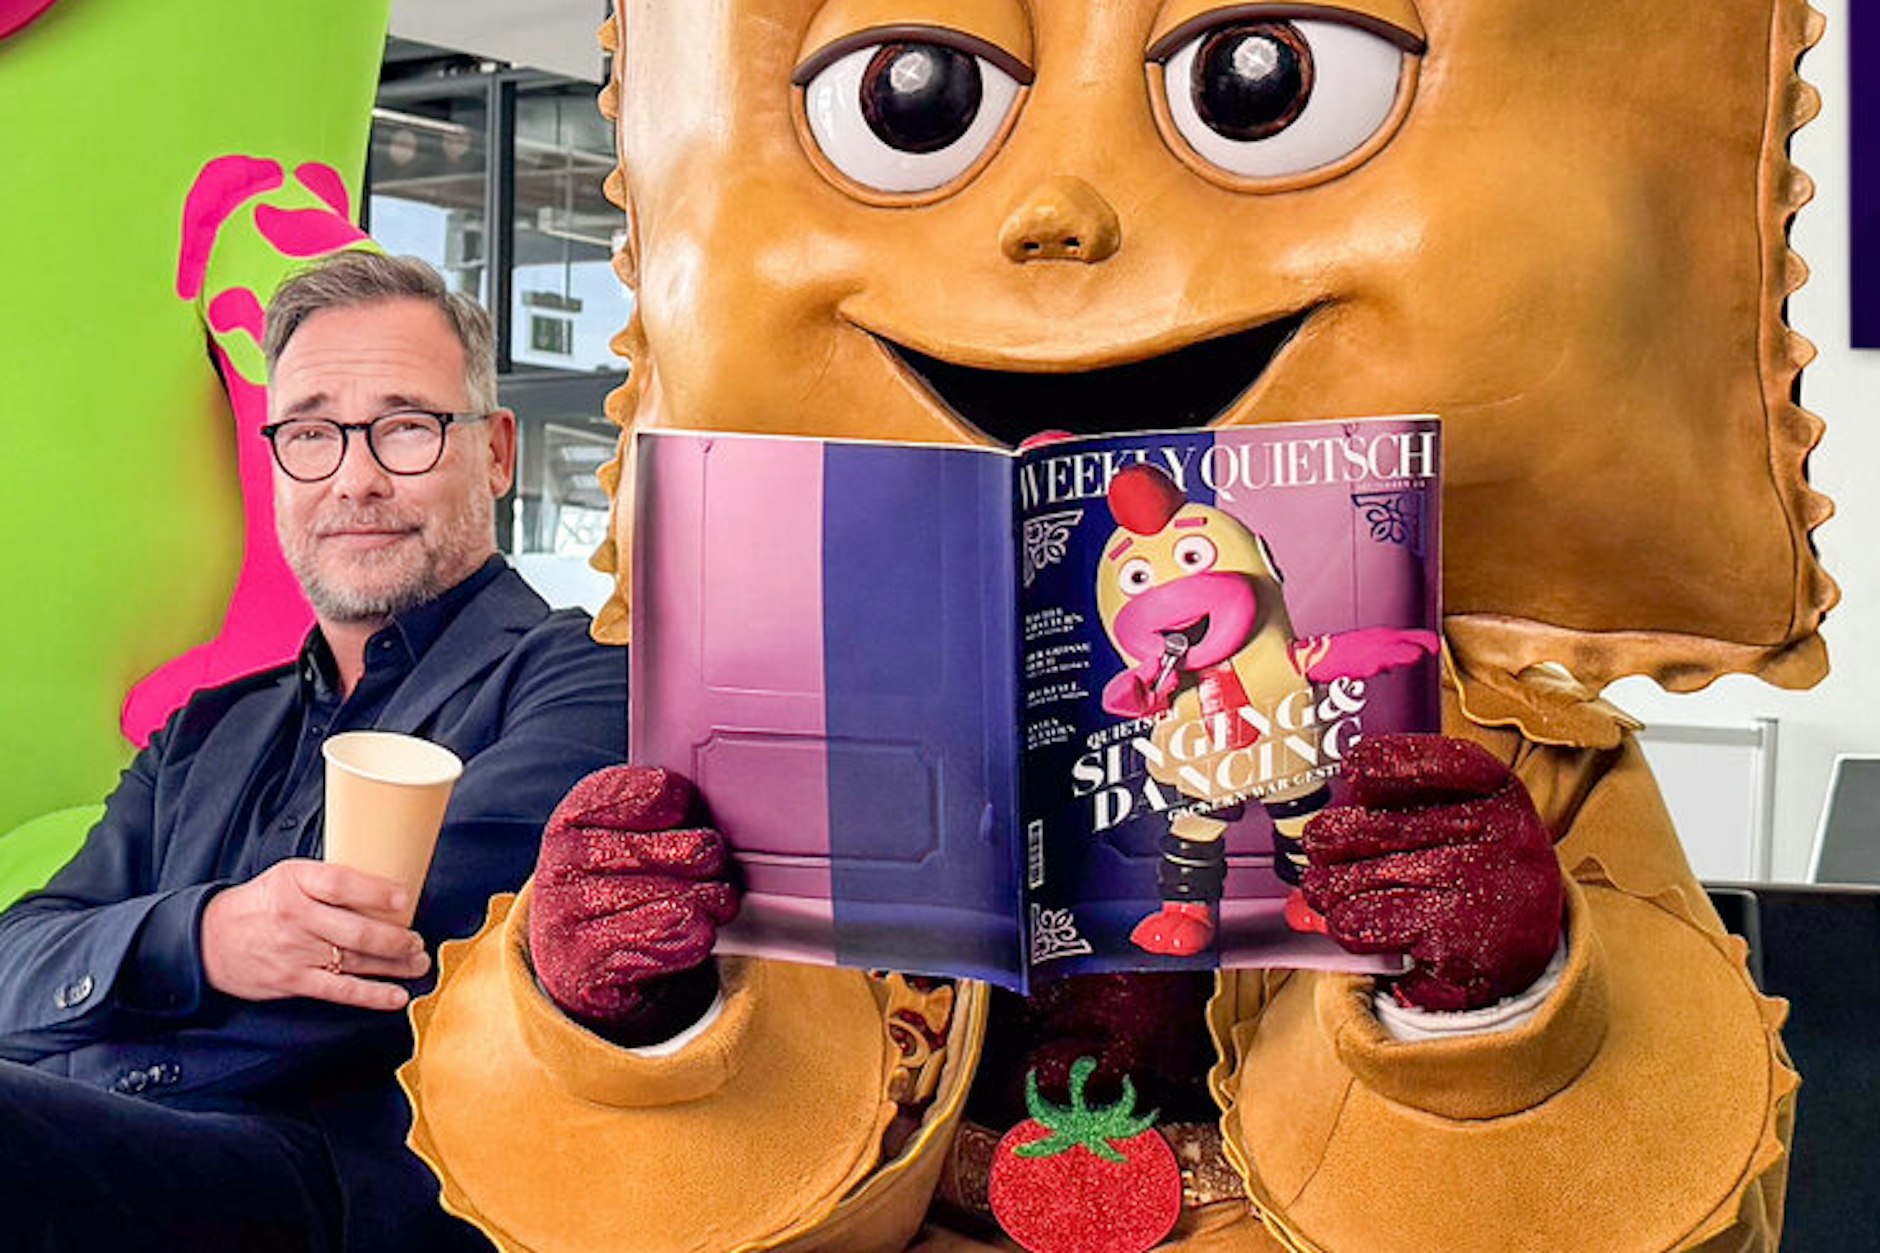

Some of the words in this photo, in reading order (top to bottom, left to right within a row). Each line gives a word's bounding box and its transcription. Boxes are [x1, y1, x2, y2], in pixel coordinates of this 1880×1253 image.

[1020, 447, 1197, 511] WEEKY
[1201, 431, 1438, 502] QUIETSCH
[1092, 717, 1363, 833] DANCING
